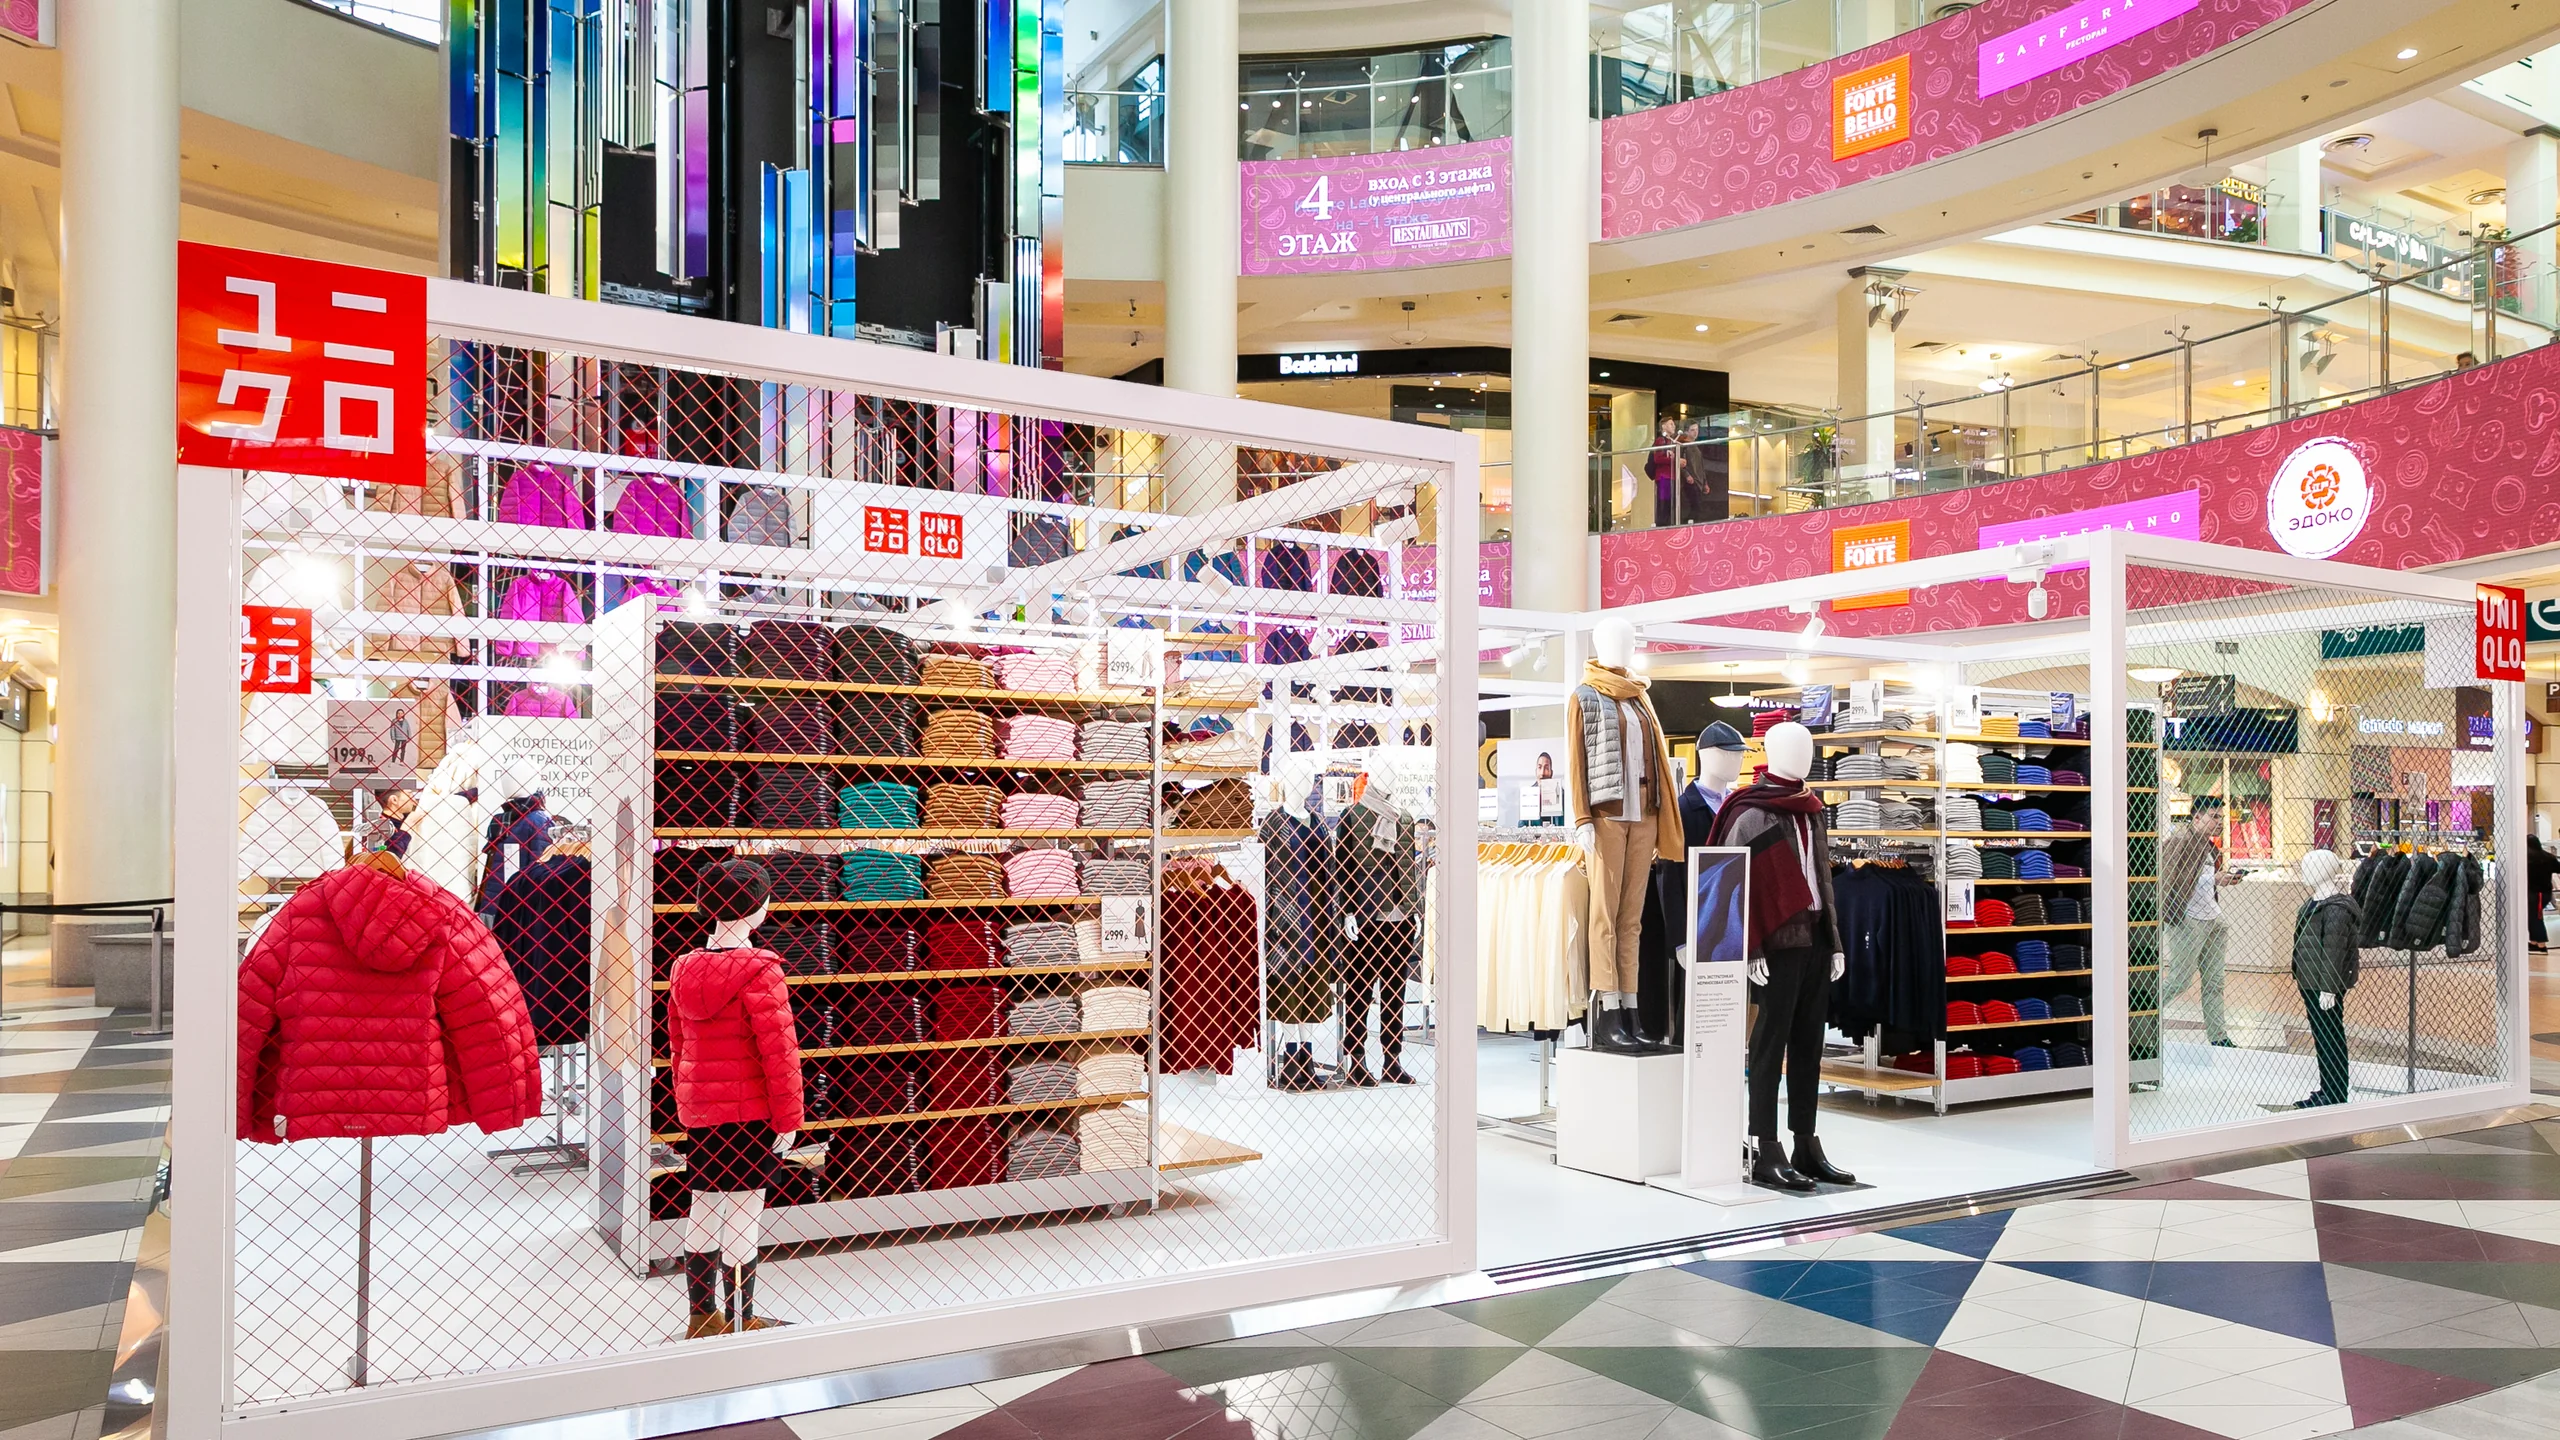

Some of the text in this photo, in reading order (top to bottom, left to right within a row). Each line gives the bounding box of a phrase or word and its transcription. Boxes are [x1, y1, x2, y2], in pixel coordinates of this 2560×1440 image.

[1844, 81, 1896, 115] FORTE
[1844, 103, 1897, 136] BELLO
[1425, 170, 1435, 186] 3
[1301, 175, 1333, 221] 4
[1279, 232, 1358, 256] ЭТАЖ
[1393, 221, 1467, 243] RESTAURANTS
[924, 516, 956, 536] UNI
[2289, 507, 2353, 531] ЭДОКО
[924, 535, 959, 555] QLO
[1844, 543, 1896, 568] FORTE
[2483, 597, 2517, 630] UNI
[2483, 635, 2521, 673] QLO
[333, 747, 365, 762] 1999
[1105, 929, 1124, 941] 2999
